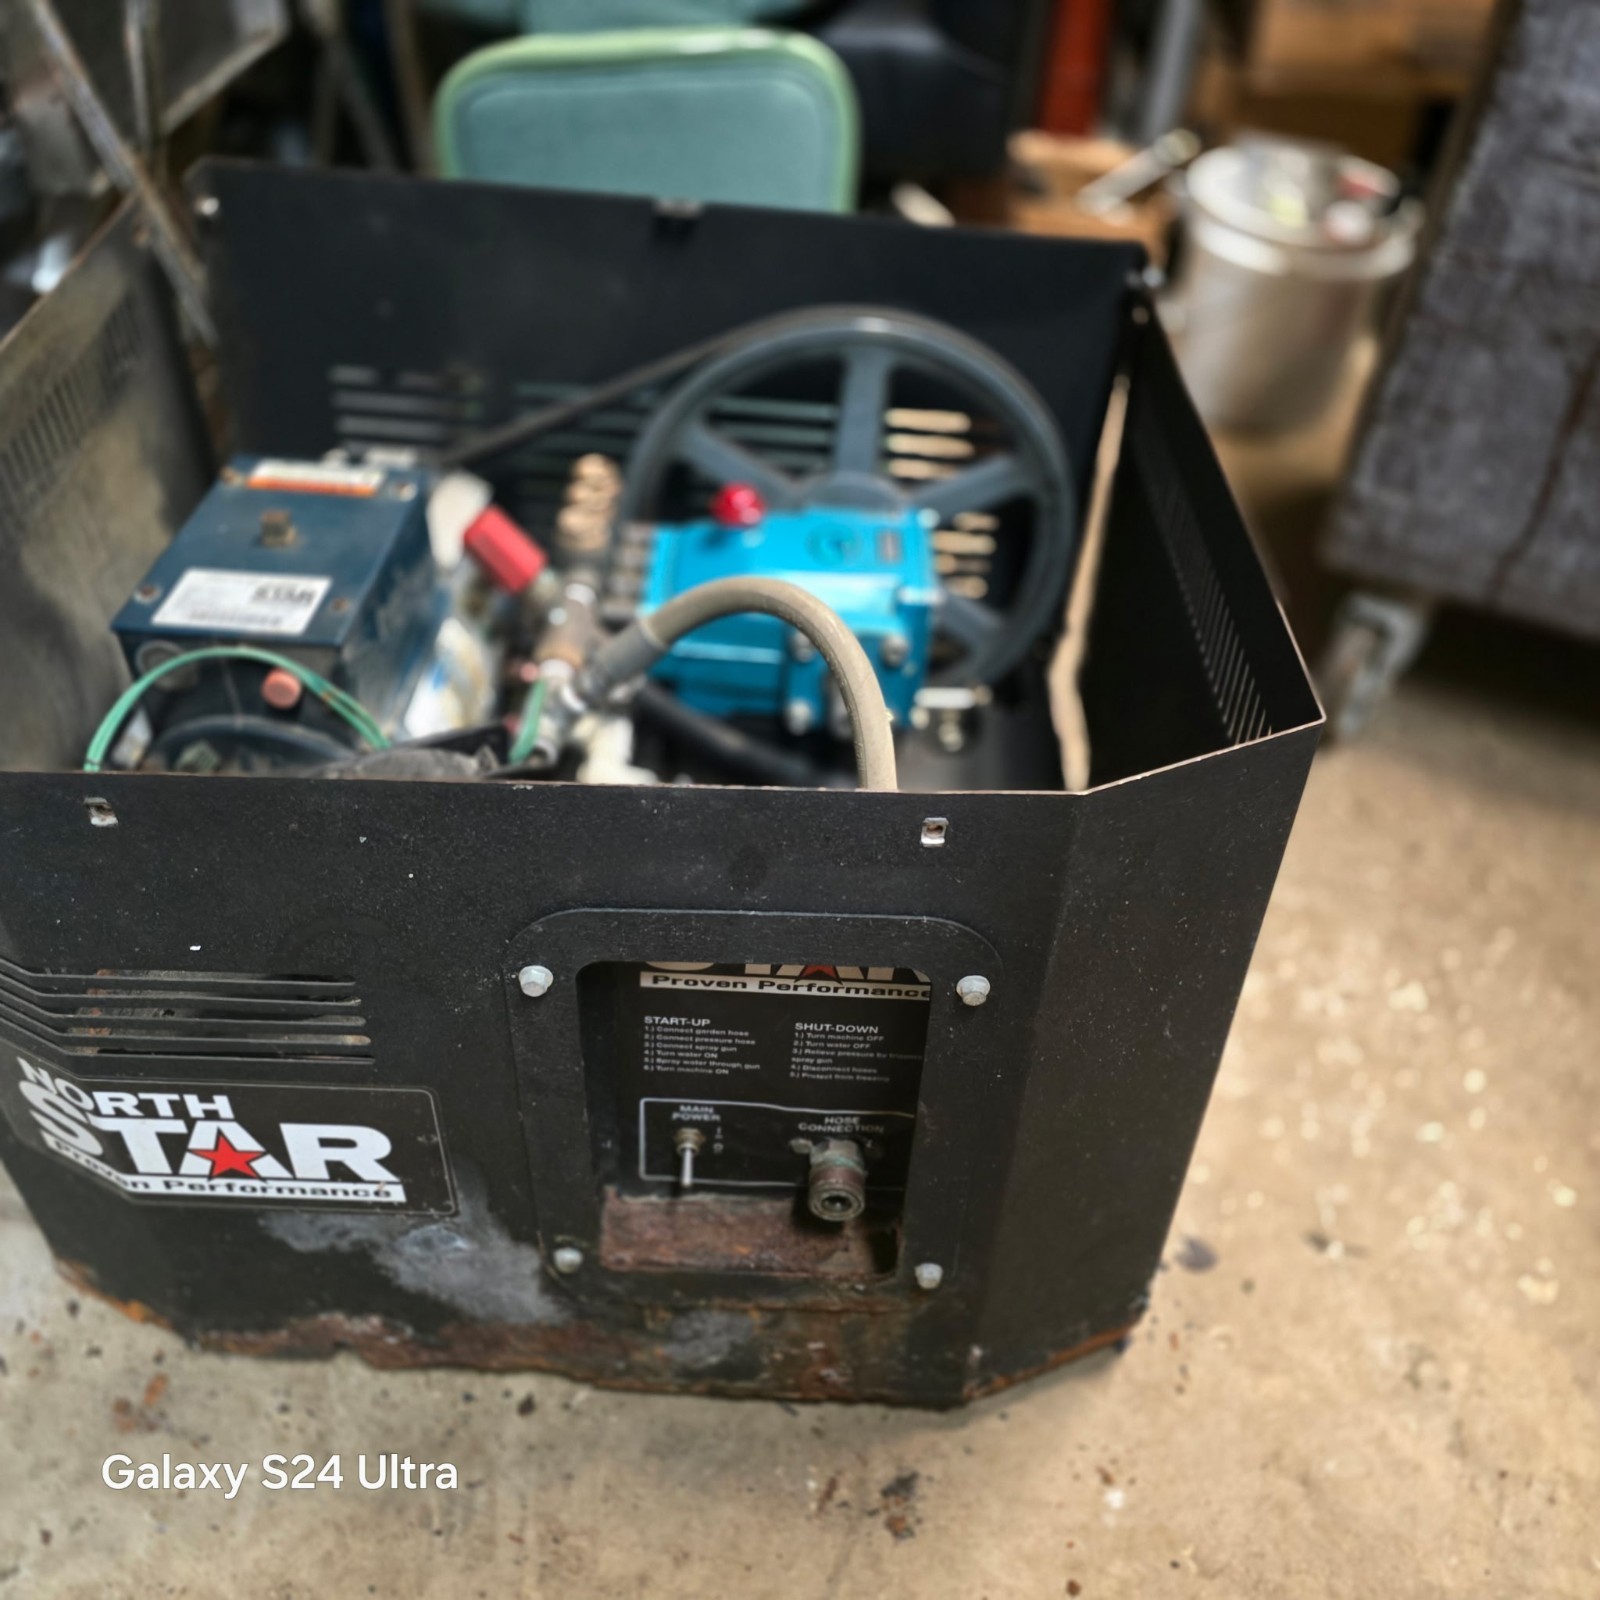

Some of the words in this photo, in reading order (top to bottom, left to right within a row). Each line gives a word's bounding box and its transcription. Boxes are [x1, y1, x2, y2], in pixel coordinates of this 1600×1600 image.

[651, 974, 748, 989] Proven
[644, 1016, 711, 1026] START-UP
[656, 1026, 694, 1034] Connect
[695, 1028, 726, 1036] garden
[727, 1029, 750, 1037] hose
[794, 1022, 879, 1034] SHUT-DOWN
[656, 1034, 694, 1042] Connect
[695, 1036, 733, 1045] pressure
[806, 1032, 826, 1040] Turn
[656, 1042, 693, 1050] Connect
[694, 1044, 719, 1053] spray
[656, 1049, 676, 1057] Turn
[804, 1048, 836, 1056] Relieve
[837, 1051, 875, 1059] pressure
[656, 1057, 681, 1066] Spray
[682, 1059, 708, 1067] water
[677, 1066, 713, 1074] machine
[802, 1064, 851, 1073] Disconnect
[801, 1071, 833, 1080] Protect
[17, 1056, 235, 1120] NORTH
[679, 1105, 715, 1114] MAIN
[671, 1112, 721, 1122] POWER
[824, 1116, 861, 1125] HOSE
[18, 1081, 401, 1183] STAR
[797, 1122, 885, 1134] CONNECTION
[53, 1140, 150, 1190] Proven
[163, 1179, 392, 1198] Performance
